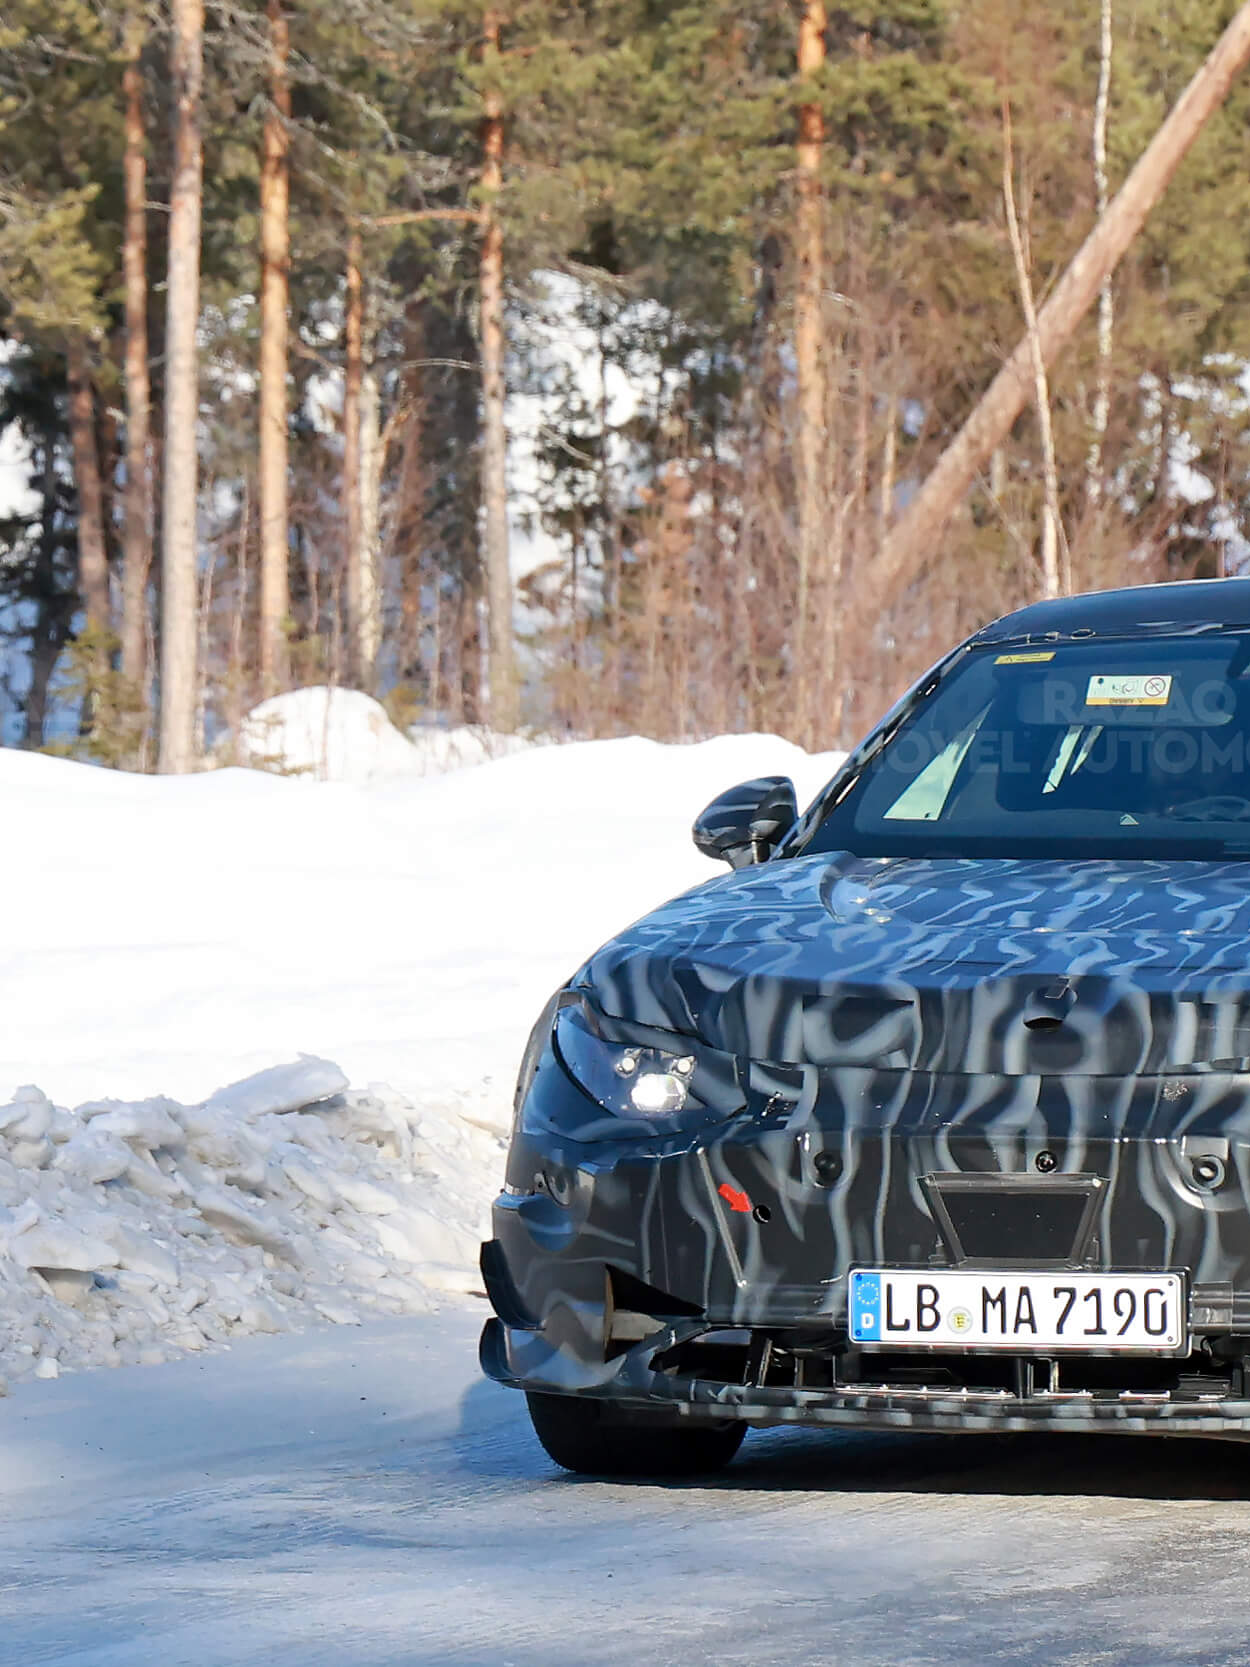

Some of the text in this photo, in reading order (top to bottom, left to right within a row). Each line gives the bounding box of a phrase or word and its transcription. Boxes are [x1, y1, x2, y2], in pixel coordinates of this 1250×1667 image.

[861, 1313, 874, 1328] D
[886, 1283, 1168, 1336] LB MA 7190
